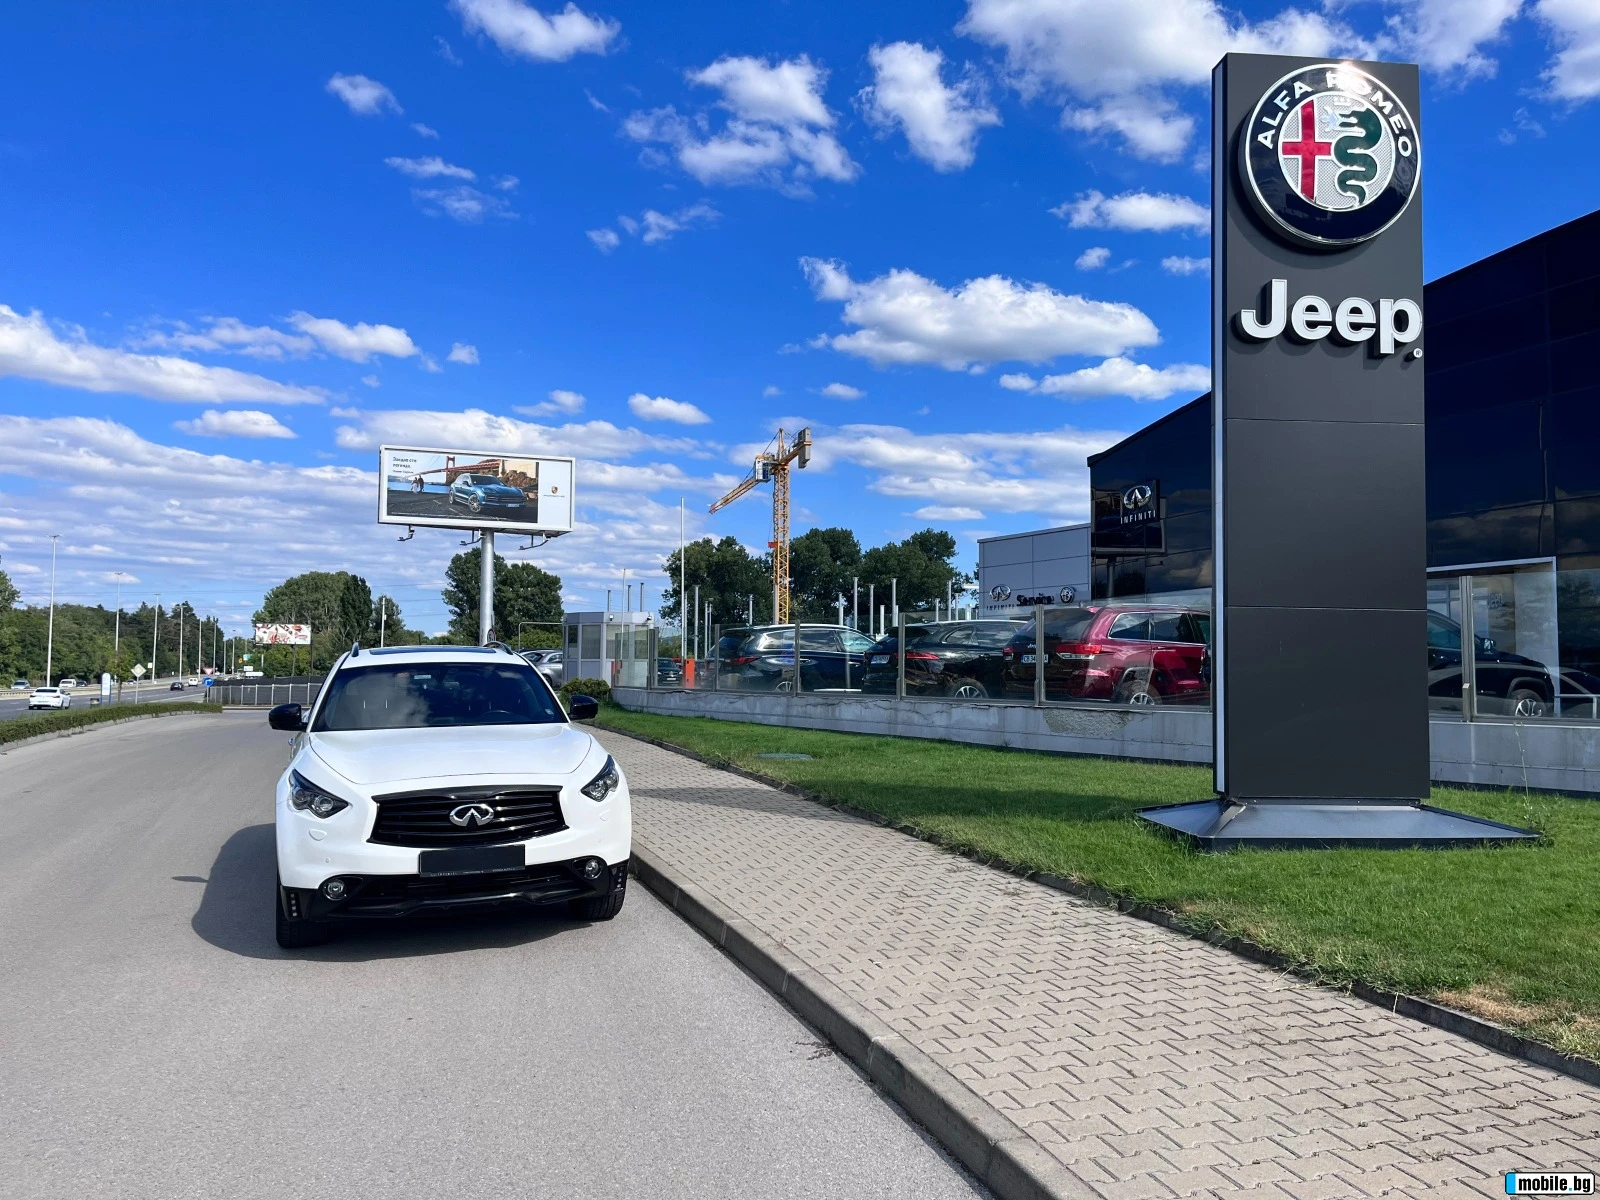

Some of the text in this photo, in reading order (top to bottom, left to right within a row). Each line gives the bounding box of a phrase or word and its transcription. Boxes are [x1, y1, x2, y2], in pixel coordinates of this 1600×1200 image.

[1257, 71, 1412, 157] ALFA ROMEO
[1240, 278, 1423, 354] Jeep
[1120, 510, 1156, 525] INFINITI
